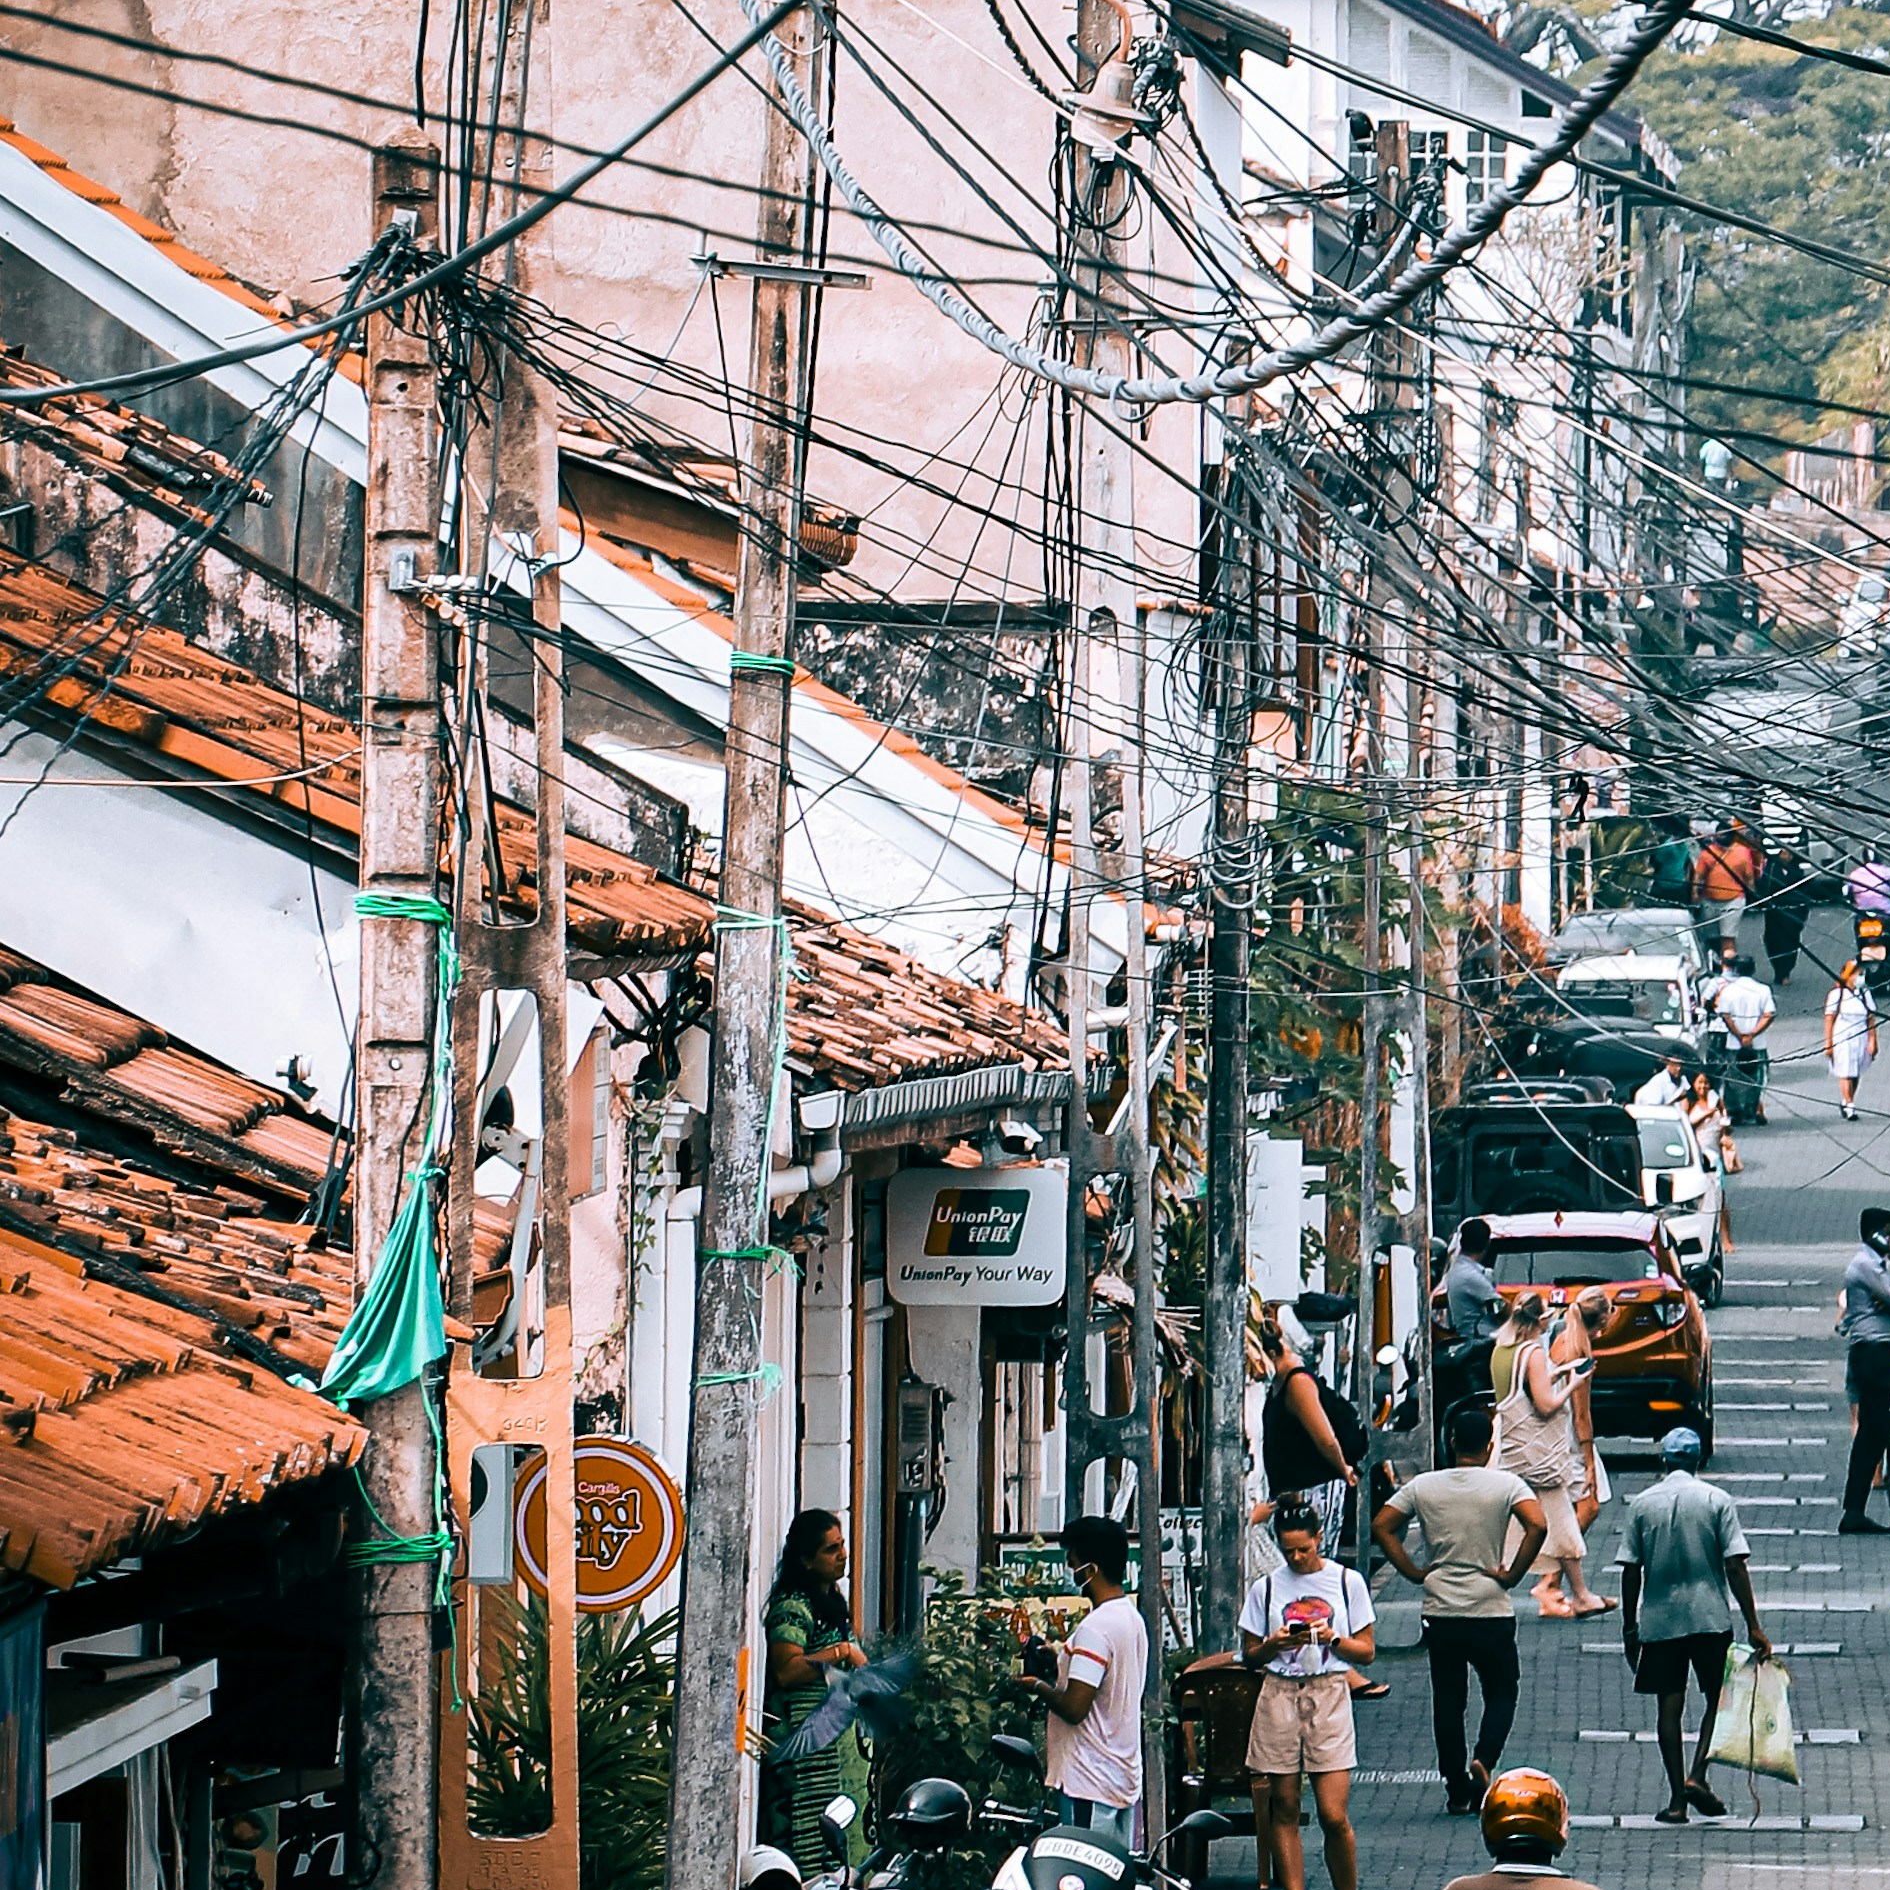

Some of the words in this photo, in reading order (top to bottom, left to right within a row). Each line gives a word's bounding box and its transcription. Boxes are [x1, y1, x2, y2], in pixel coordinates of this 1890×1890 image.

[936, 1206, 1022, 1230] UnionPay
[901, 1265, 972, 1287] UnionPay
[976, 1265, 1012, 1282] Your
[1017, 1265, 1053, 1285] Way
[578, 1481, 620, 1496] Cargills
